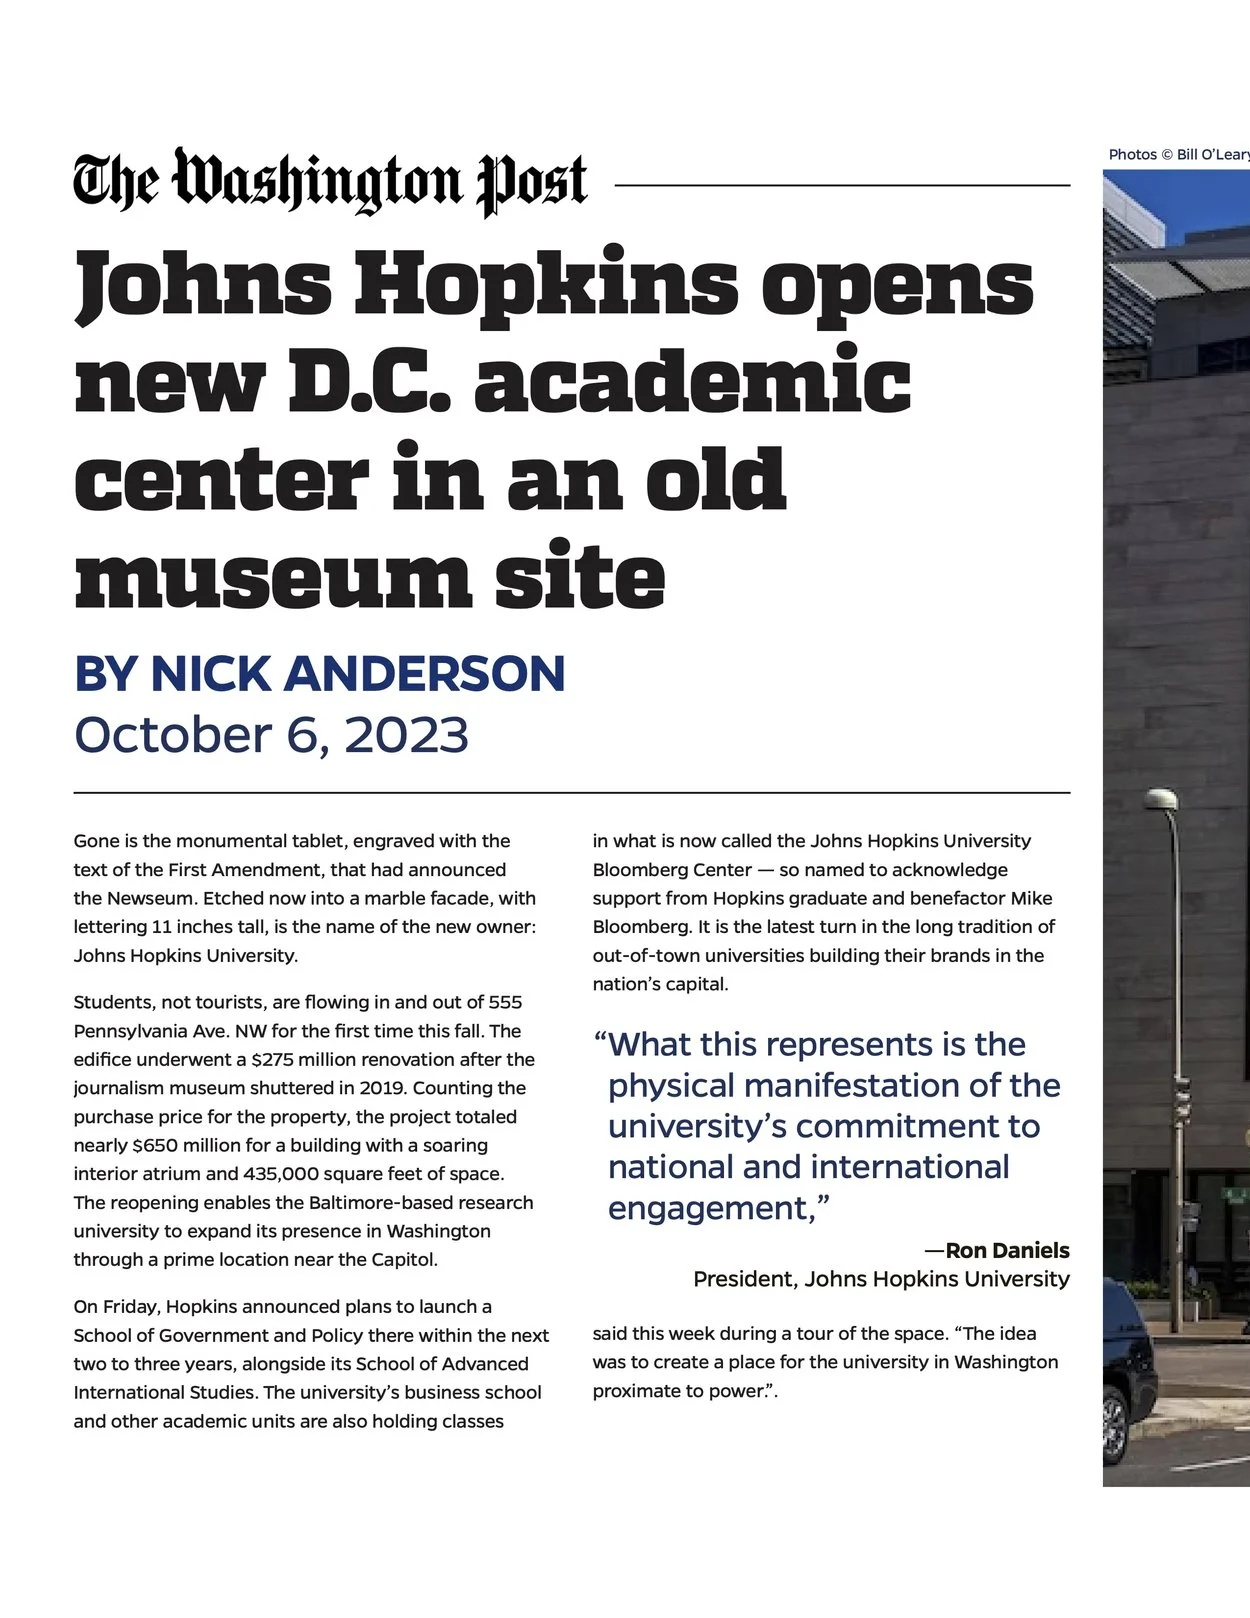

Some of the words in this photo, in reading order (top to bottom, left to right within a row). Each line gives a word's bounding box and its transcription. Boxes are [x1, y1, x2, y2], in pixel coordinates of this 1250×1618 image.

[72, 154, 160, 212] The
[170, 146, 464, 217] Washington
[475, 154, 588, 220] Post
[73, 250, 331, 328] Johns
[354, 243, 738, 331] Hopkins
[762, 263, 1033, 331] opens
[75, 361, 266, 413] new
[288, 347, 451, 413] D.C.
[474, 341, 910, 413] academic
[74, 447, 369, 511] center
[392, 439, 484, 510] in
[507, 459, 623, 510] an
[646, 446, 787, 511] old
[75, 557, 473, 609] museum
[495, 537, 665, 609] site
[76, 656, 139, 691] BY
[152, 655, 272, 691] NICK
[282, 655, 564, 691] ANDERSON
[75, 714, 272, 753] October
[287, 716, 328, 759] 6,
[345, 716, 468, 753] 2023
[73, 834, 119, 848] Gone
[125, 834, 137, 848] is
[142, 834, 171, 847] the
[176, 833, 286, 848] monumental
[291, 833, 348, 850] tablet,
[353, 833, 434, 851] engraved
[438, 833, 476, 847] with
[481, 834, 510, 847] the
[593, 862, 688, 880] Bloomberg
[693, 863, 752, 876] Center
[779, 866, 799, 876] so
[805, 862, 864, 876] named
[868, 864, 887, 876] to
[892, 862, 1008, 879] acknowledge
[74, 919, 147, 936] lettering
[152, 920, 171, 933] 11
[177, 919, 232, 933] inches
[237, 919, 268, 935] tall,
[274, 919, 287, 933] is
[291, 919, 320, 933] the
[326, 923, 374, 933] name
[379, 919, 398, 933] of
[401, 919, 430, 933] the
[435, 923, 471, 933] new
[476, 923, 535, 933] owner:
[593, 919, 692, 936] Bloomberg.
[698, 920, 710, 933] It
[715, 919, 728, 933] is
[733, 919, 761, 933] the
[767, 919, 814, 933] latest
[819, 921, 856, 933] turn
[861, 919, 876, 933] in
[881, 919, 910, 933] the
[915, 919, 953, 936] long
[957, 919, 1032, 933] tradition
[1037, 919, 1056, 933] of
[73, 948, 125, 962] Johns
[130, 948, 201, 965] Hopkins
[207, 948, 297, 965] University.
[665, 977, 728, 994] capital.
[74, 1024, 187, 1040] Pennsylvania
[192, 1025, 229, 1038] Ave.
[235, 1025, 267, 1038] NW
[271, 1023, 297, 1038] for
[301, 1024, 330, 1038] the
[334, 1023, 369, 1038] first
[373, 1024, 413, 1038] time
[417, 1024, 450, 1038] this
[454, 1023, 484, 1038] fall.
[488, 1024, 521, 1038] The
[699, 1031, 756, 1056] this
[767, 1033, 932, 1062] represents
[943, 1031, 965, 1056] is
[974, 1031, 1025, 1056] the
[73, 1081, 163, 1098] journalism
[169, 1084, 245, 1095] museum
[250, 1081, 333, 1095] shuttered
[339, 1081, 354, 1094] in
[359, 1081, 407, 1095] 2019.
[413, 1081, 492, 1098] Counting
[497, 1081, 526, 1095] the
[609, 1072, 733, 1103] physical
[745, 1072, 958, 1097] manifestation
[969, 1072, 1002, 1097] of
[1009, 1072, 1060, 1097] the
[796, 1113, 999, 1138] commitment
[1007, 1115, 1040, 1138] to
[74, 1138, 128, 1155] nearly
[132, 1139, 177, 1153] $650
[183, 1138, 240, 1152] million
[245, 1138, 271, 1152] for
[275, 1142, 285, 1152] a
[290, 1138, 360, 1155] building
[365, 1138, 402, 1152] with
[407, 1141, 417, 1152] a
[423, 1138, 487, 1155] soaring
[609, 1154, 732, 1179] national
[743, 1154, 800, 1179] and
[811, 1153, 1008, 1179] international
[73, 1195, 105, 1209] The
[111, 1195, 198, 1212] reopening
[203, 1195, 270, 1209] enables
[275, 1195, 304, 1209] the
[309, 1195, 453, 1209] Baltimore-based
[459, 1195, 533, 1209] research
[993, 1241, 1070, 1258] Daniels
[73, 1252, 143, 1269] through
[148, 1256, 157, 1266] a
[163, 1252, 214, 1269] prime
[219, 1252, 288, 1266] location
[294, 1256, 334, 1266] near
[337, 1252, 366, 1266] the
[371, 1252, 437, 1269] Capitol.
[694, 1270, 798, 1289] President,
[804, 1270, 867, 1287] Johns
[873, 1270, 958, 1291] Hopkins
[965, 1270, 1070, 1290] University
[73, 1328, 131, 1342] School
[136, 1328, 155, 1342] of
[159, 1329, 269, 1342] Government
[273, 1328, 305, 1342] and
[312, 1328, 363, 1345] Policy
[367, 1328, 413, 1342] there
[418, 1328, 472, 1342] within
[477, 1328, 506, 1342] the
[511, 1329, 549, 1342] next
[74, 1385, 184, 1399] International
[189, 1385, 258, 1399] Studies.
[262, 1385, 295, 1399] The
[405, 1385, 480, 1399] business
[484, 1385, 541, 1399] school
[593, 1384, 681, 1401] proximate
[685, 1385, 703, 1397] to
